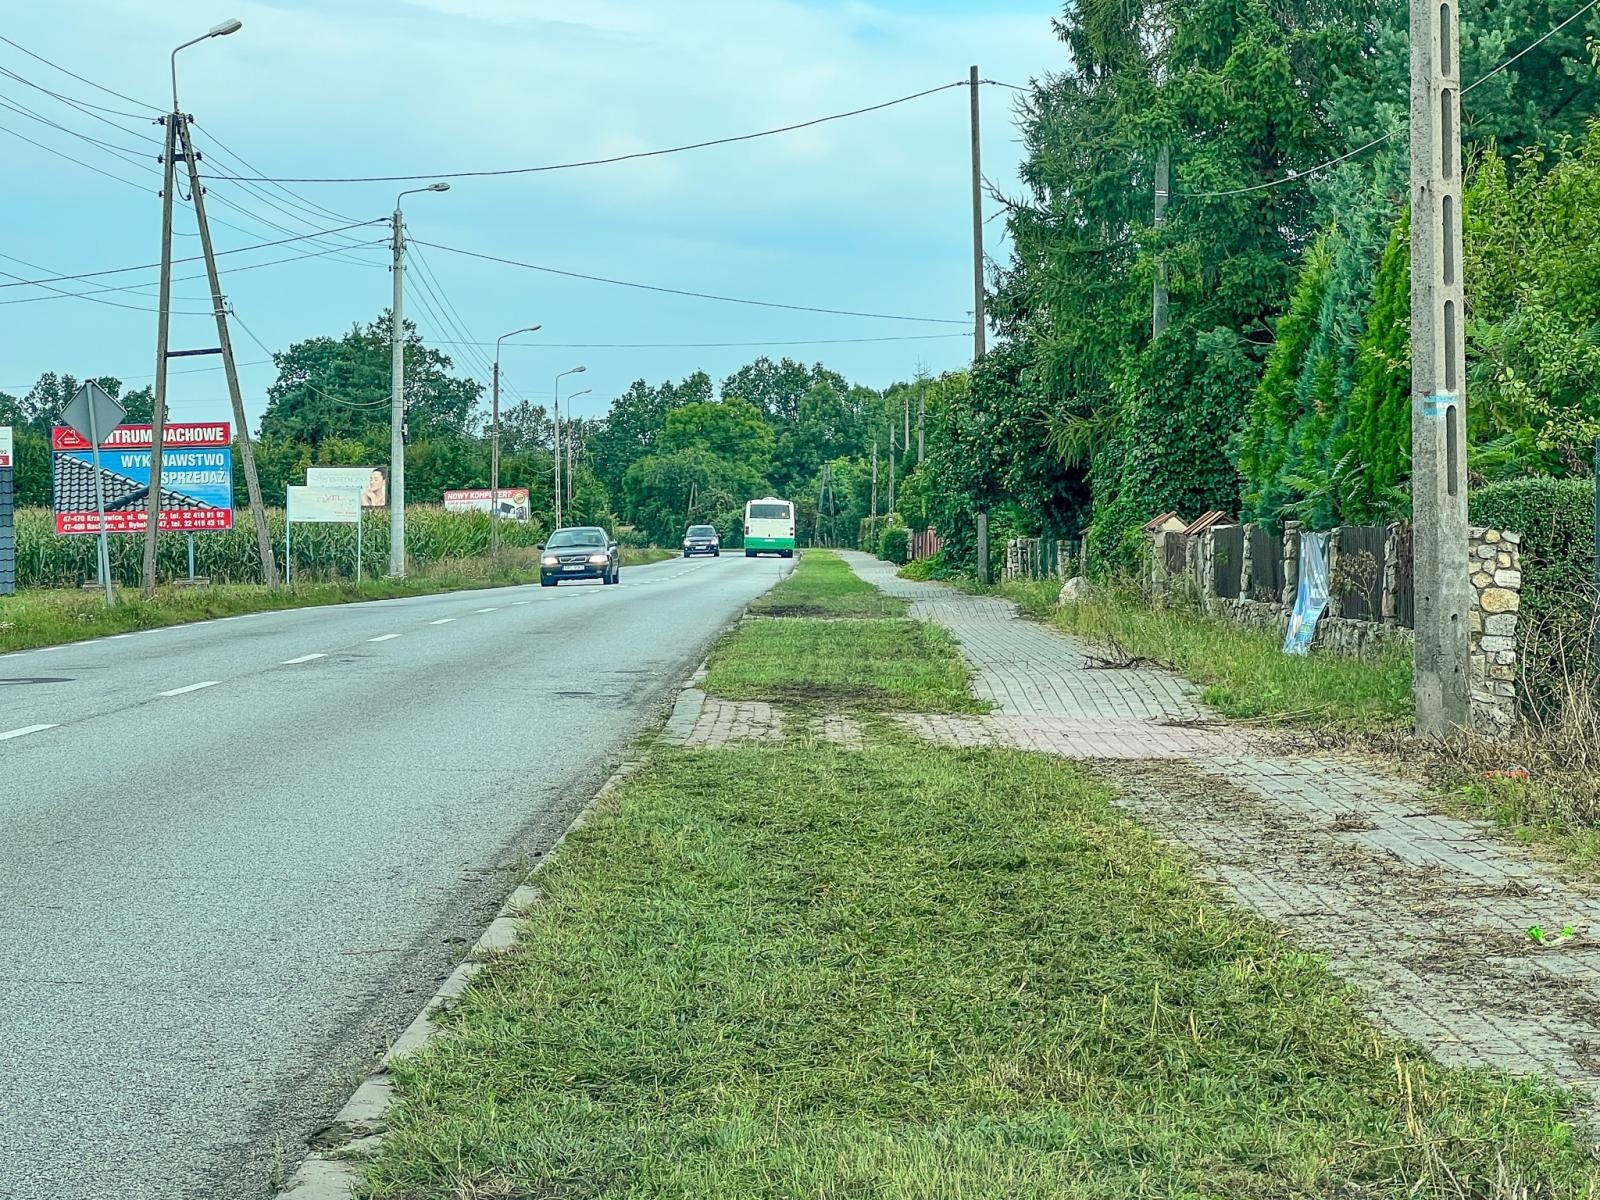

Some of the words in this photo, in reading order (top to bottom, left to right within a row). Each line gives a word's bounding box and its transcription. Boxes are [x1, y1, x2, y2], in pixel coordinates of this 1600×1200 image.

[120, 453, 225, 468] WYKNAWSTWO
[160, 468, 226, 484] SPRZEDAŻ
[447, 492, 470, 500] NOWY
[183, 511, 191, 519] 32
[193, 511, 205, 519] 410
[184, 519, 193, 527] 32
